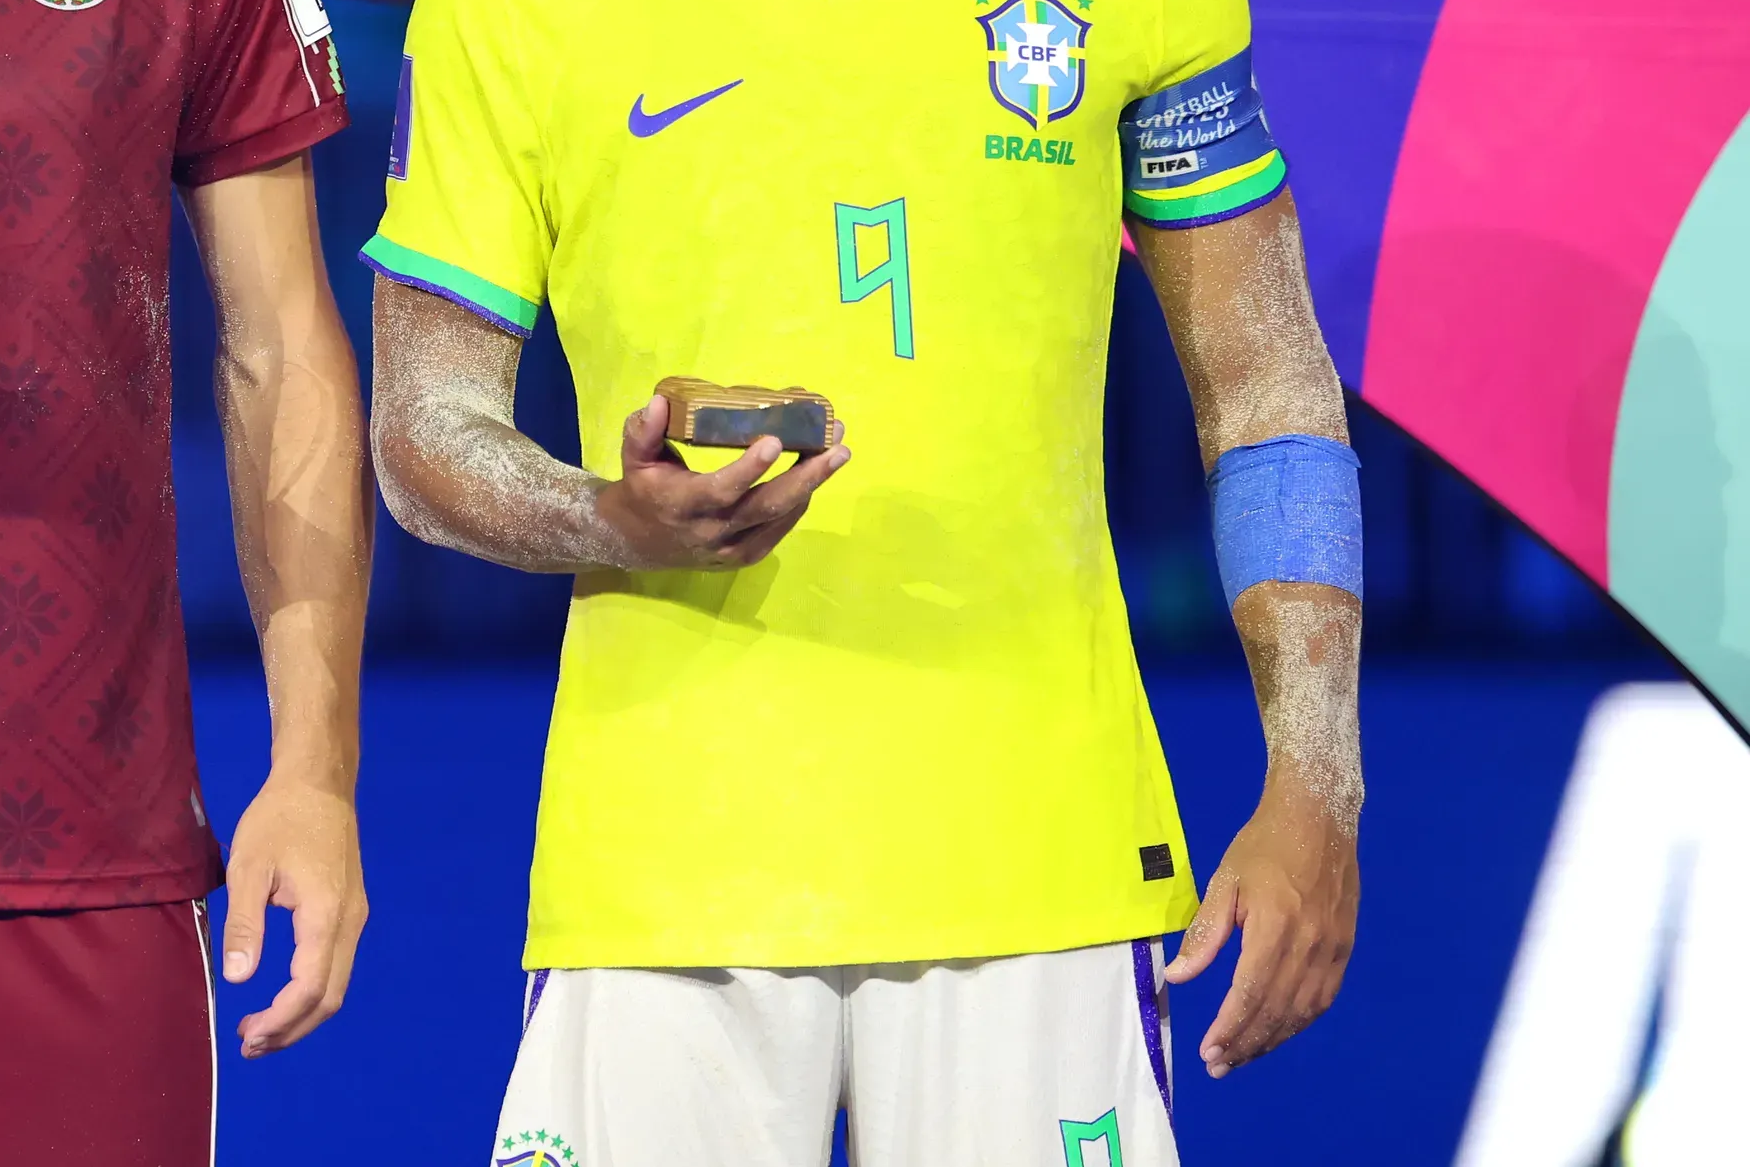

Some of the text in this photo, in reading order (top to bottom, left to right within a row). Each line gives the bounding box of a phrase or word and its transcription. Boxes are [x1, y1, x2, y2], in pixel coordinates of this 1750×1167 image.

[1018, 45, 1057, 62] CBF
[1136, 119, 1236, 150] the World
[985, 135, 1076, 166] BRASIL
[1147, 157, 1192, 174] FIFA
[834, 197, 915, 360] 9
